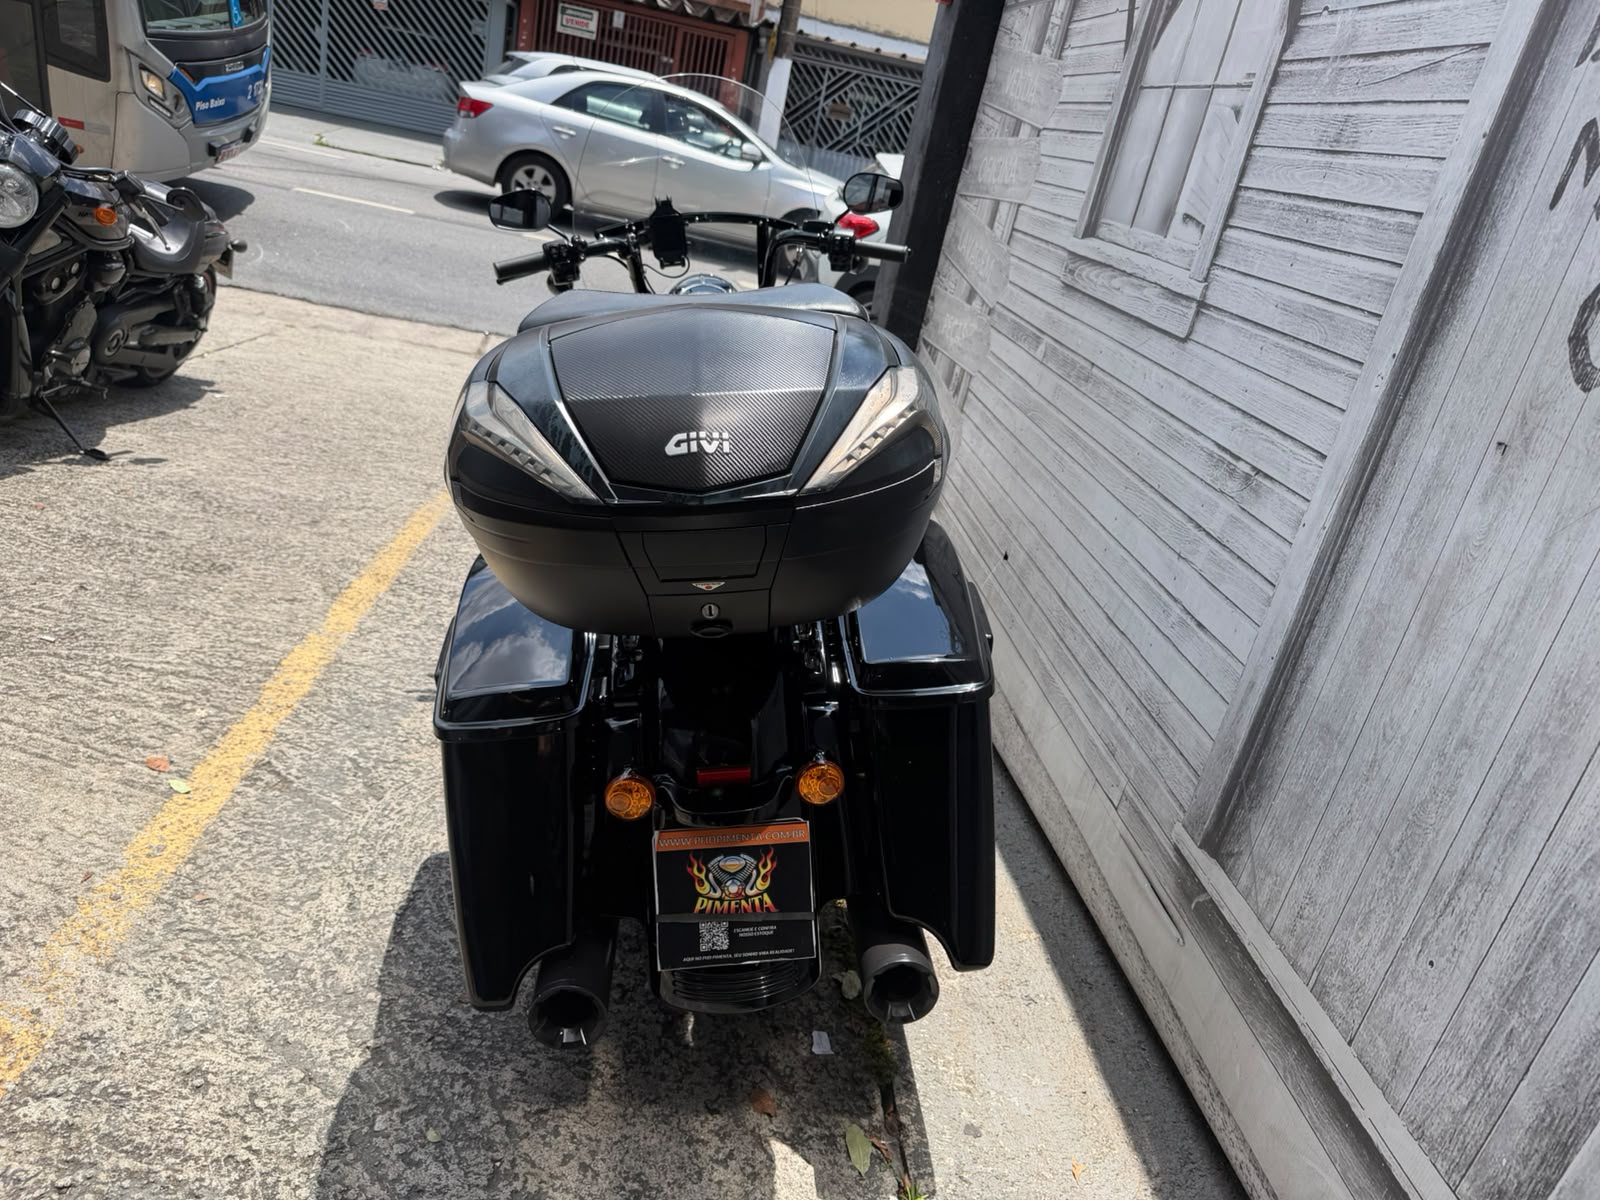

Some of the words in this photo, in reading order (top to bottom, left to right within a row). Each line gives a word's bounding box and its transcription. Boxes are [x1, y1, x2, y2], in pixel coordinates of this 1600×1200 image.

[195, 101, 209, 111] Piso
[210, 98, 225, 108] Baixo
[664, 431, 730, 456] GIVI
[693, 894, 777, 913] PIMENTA
